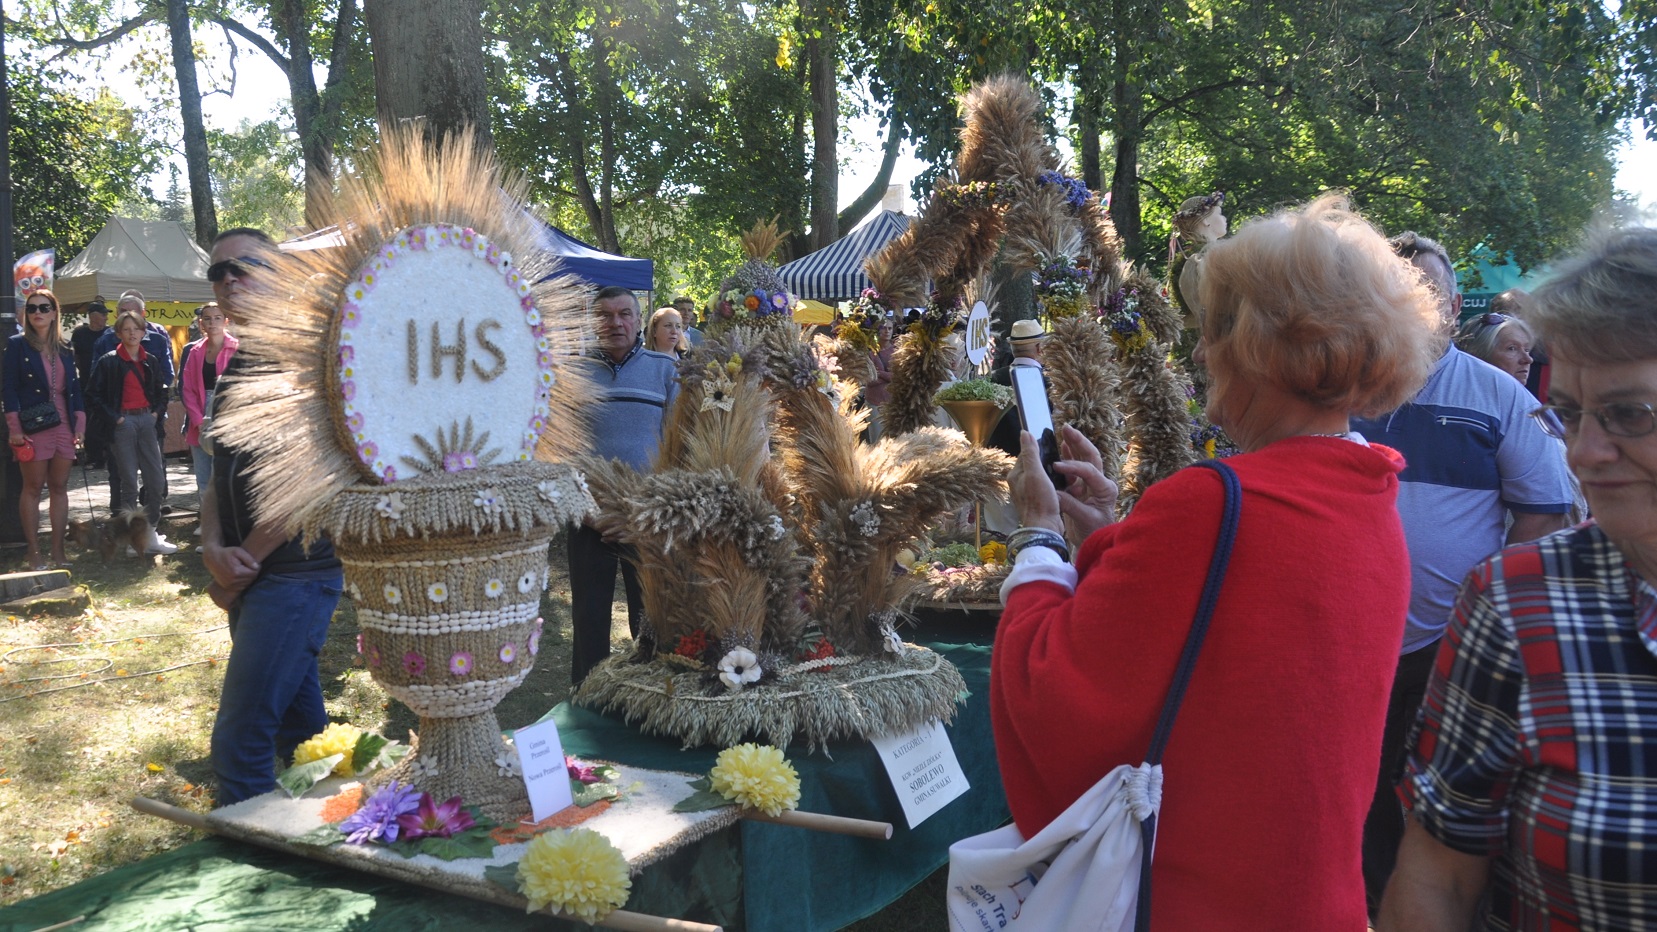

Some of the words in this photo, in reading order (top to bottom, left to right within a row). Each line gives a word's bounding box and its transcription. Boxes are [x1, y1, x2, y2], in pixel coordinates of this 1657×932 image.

[1461, 298, 1487, 308] CUJ
[970, 317, 989, 351] IHS
[407, 317, 508, 386] IHS
[529, 738, 546, 750] Gmina
[892, 736, 925, 760] KATEGORIA
[528, 771, 543, 783] Nowa
[909, 763, 945, 794] SOBOLEWO
